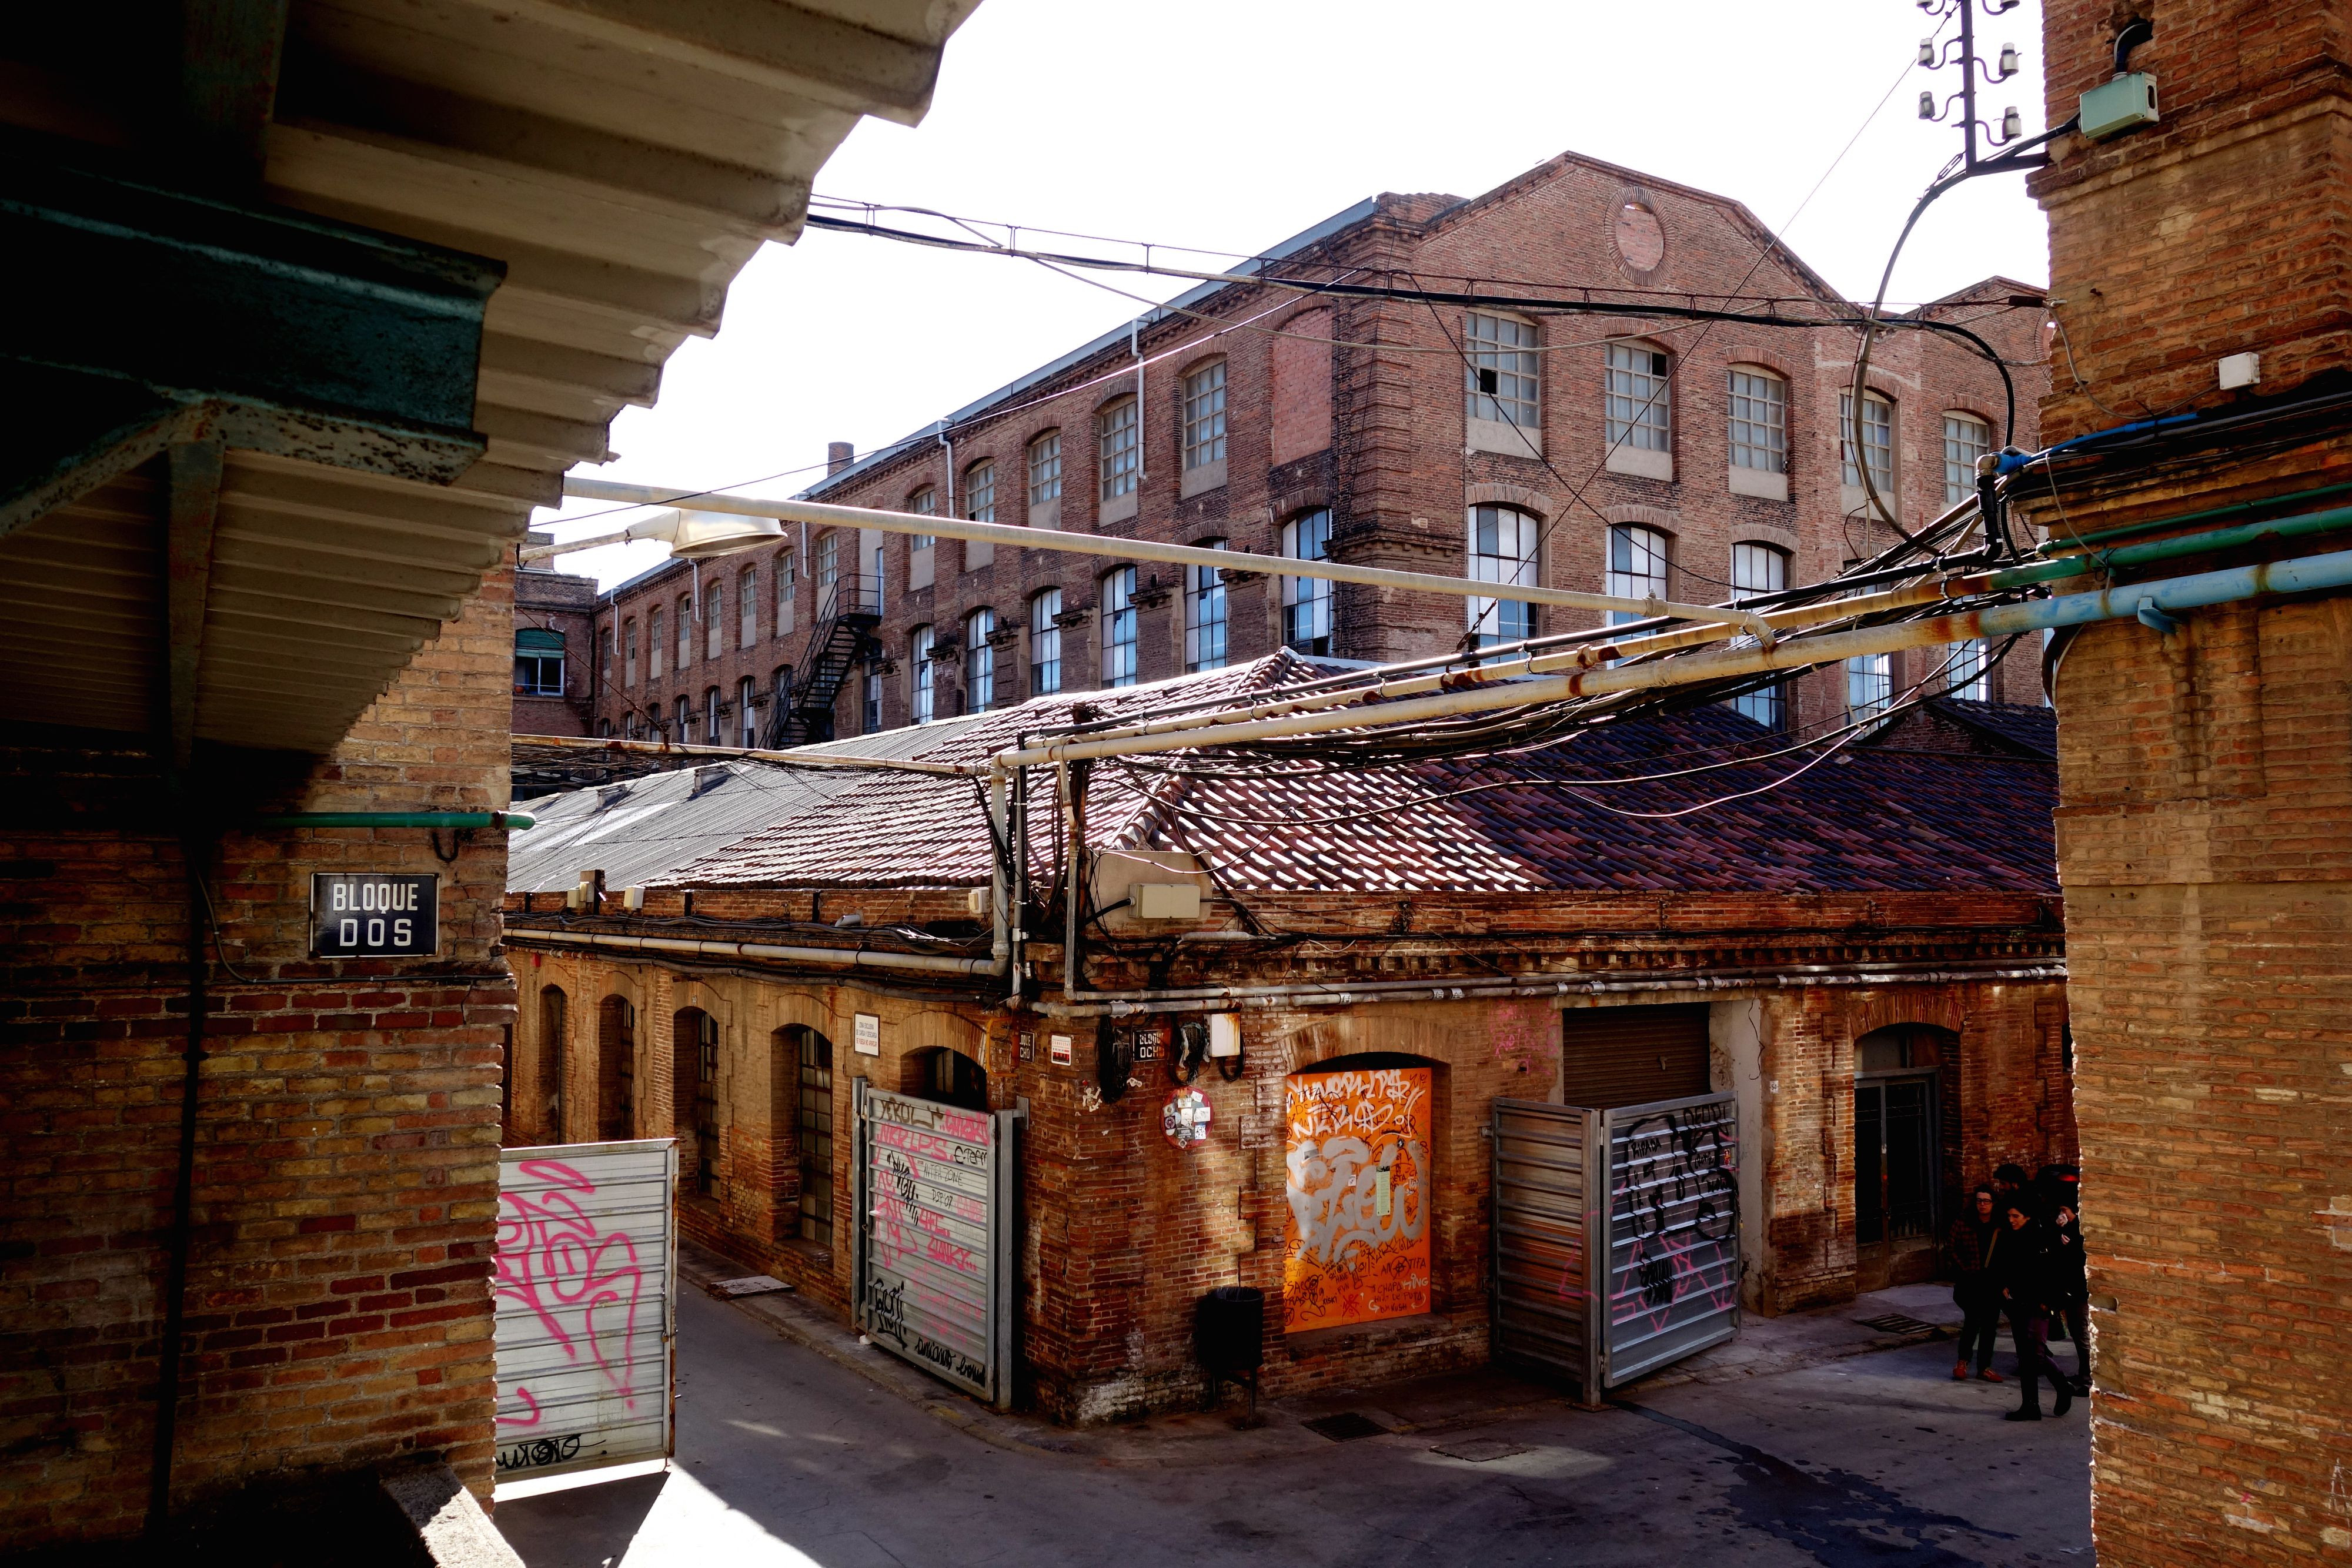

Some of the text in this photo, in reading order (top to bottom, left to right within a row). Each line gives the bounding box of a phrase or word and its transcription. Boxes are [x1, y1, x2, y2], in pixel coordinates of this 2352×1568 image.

[333, 883, 419, 914] BLOQUE
[339, 918, 412, 947] DOS
[1020, 1034, 1031, 1047] OQUE
[1020, 1047, 1030, 1059] CHO
[943, 1168, 964, 1186] ZONE
